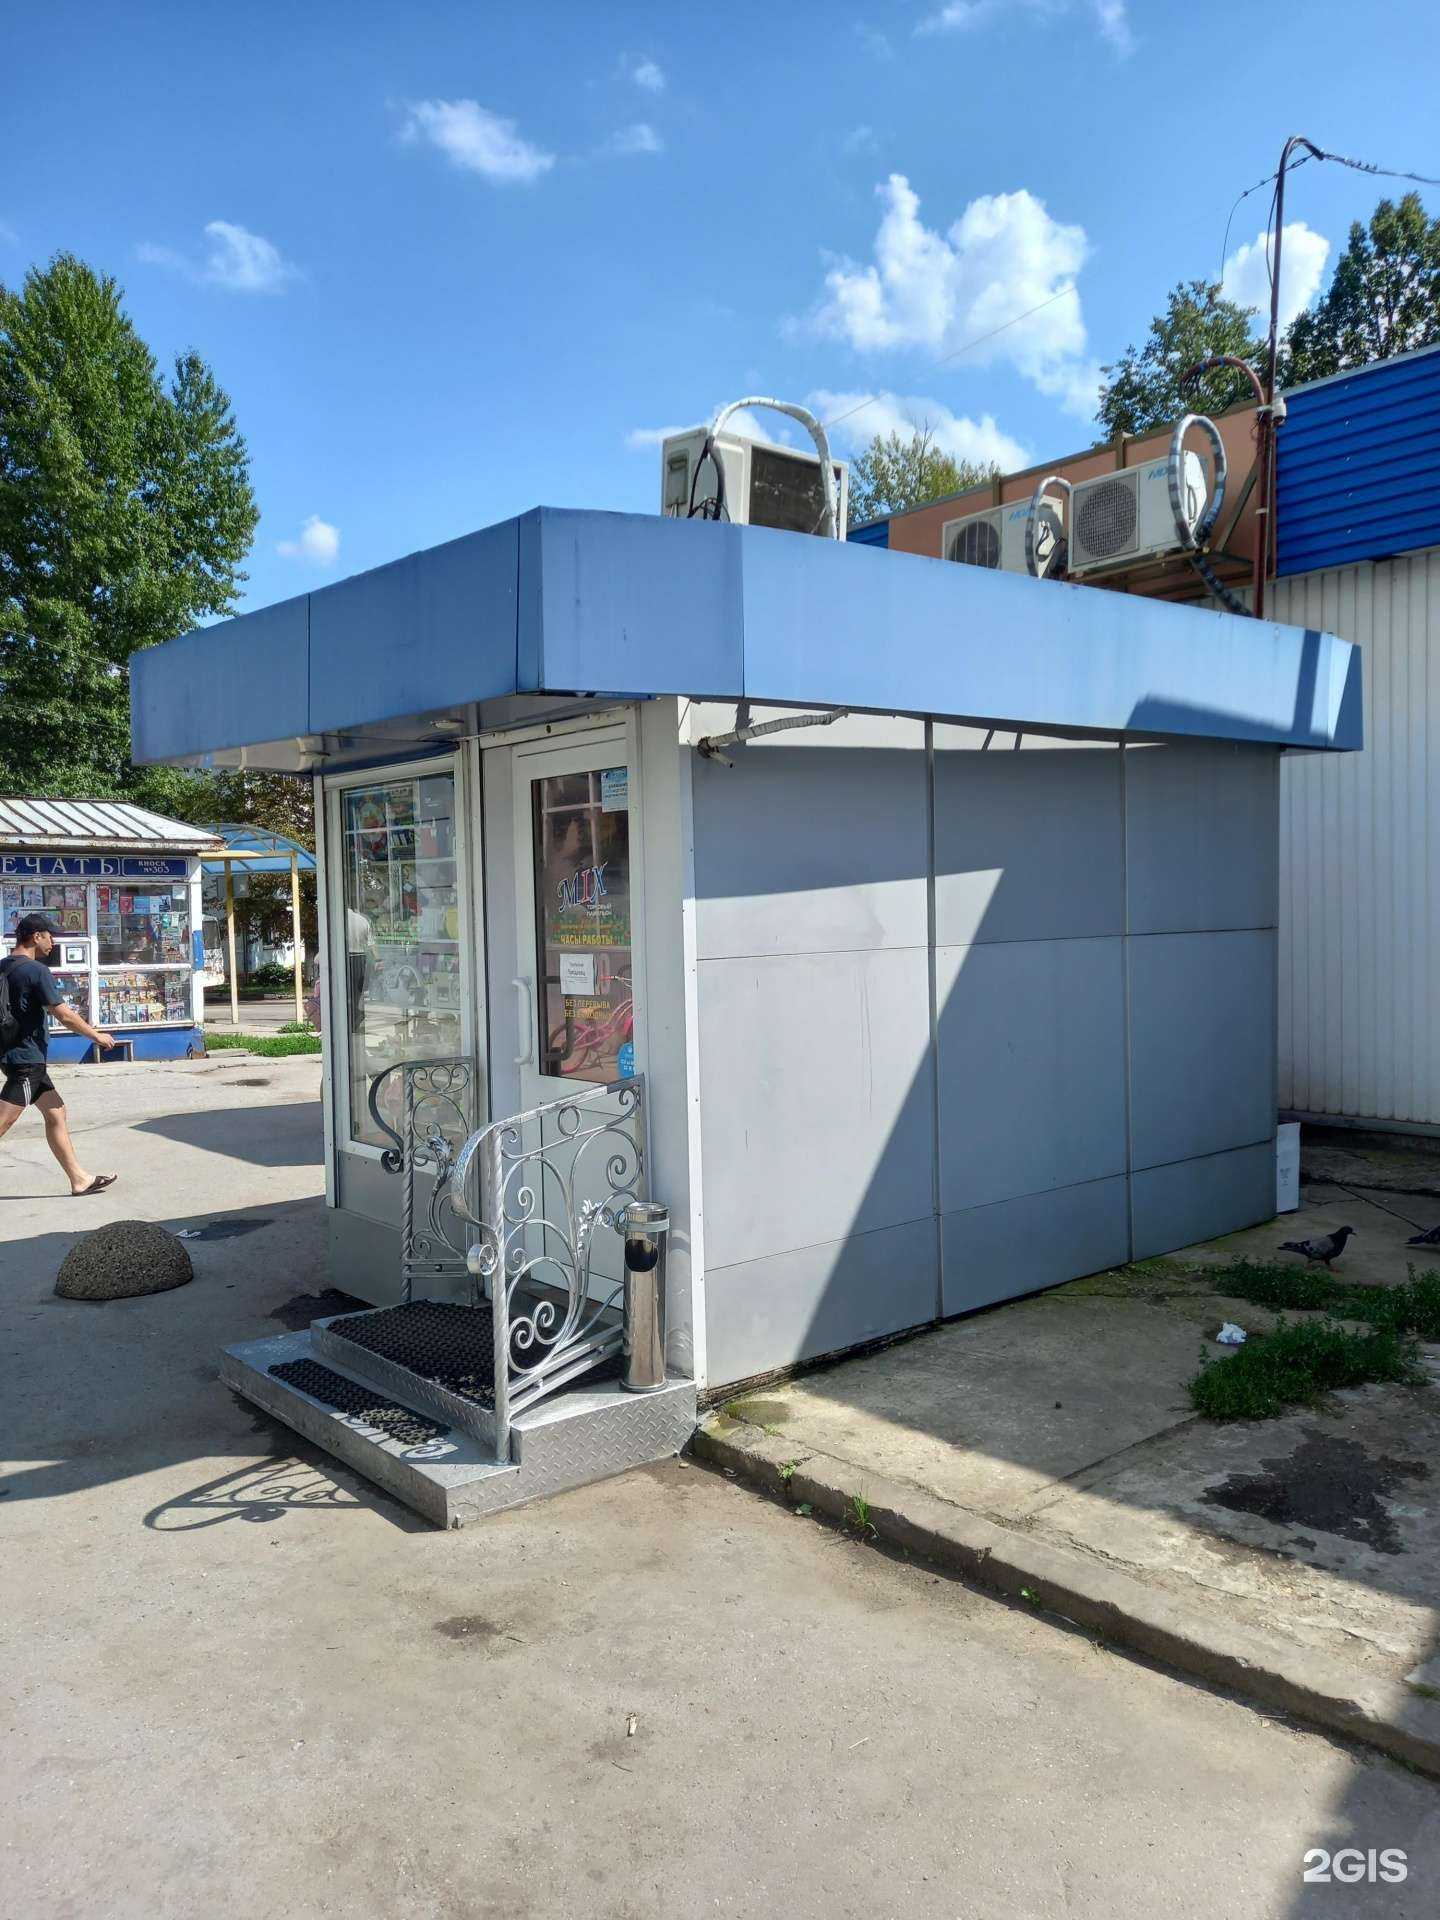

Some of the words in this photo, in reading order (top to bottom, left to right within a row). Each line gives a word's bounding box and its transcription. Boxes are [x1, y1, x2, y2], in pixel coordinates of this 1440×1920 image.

[556, 861, 608, 913] MIX
[560, 934, 581, 945] ЧАСЫ
[582, 934, 615, 945] РАБОТЫ
